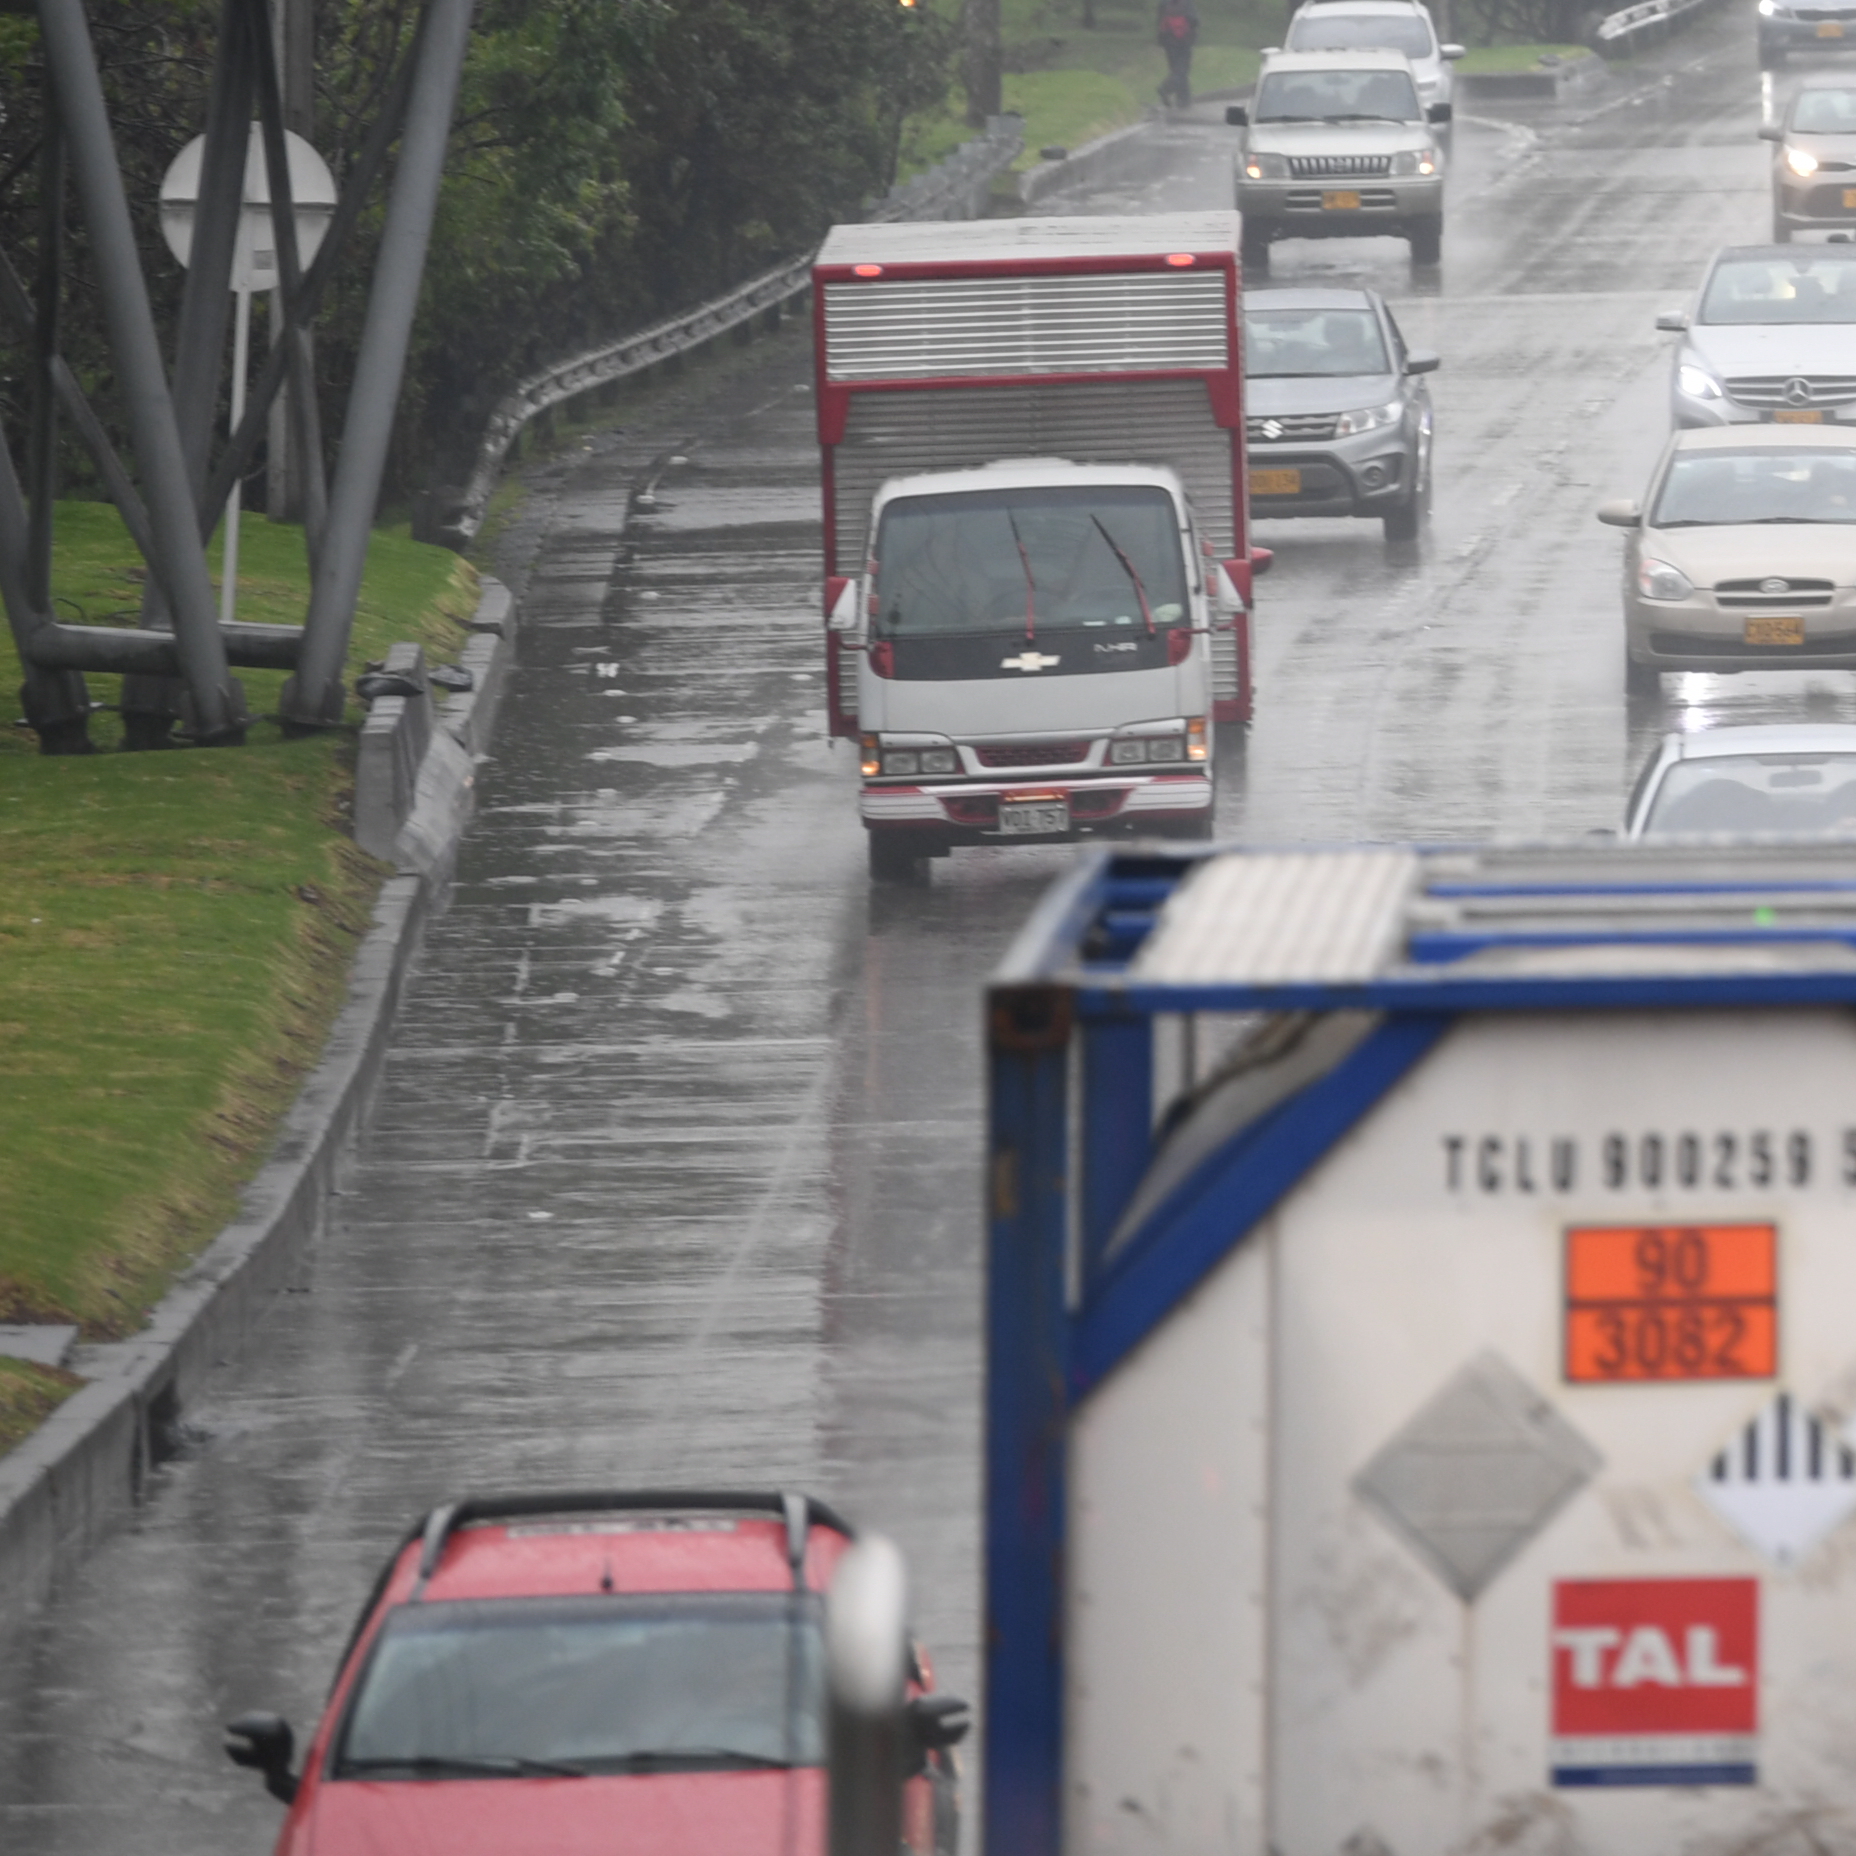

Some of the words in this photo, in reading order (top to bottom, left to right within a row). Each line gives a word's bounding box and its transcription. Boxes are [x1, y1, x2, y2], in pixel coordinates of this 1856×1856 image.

[1599, 1128, 1815, 1193] 900259
[1634, 1226, 1709, 1296] 90
[1594, 1305, 1749, 1376] 3082
[1553, 1623, 1748, 1690] TAL
